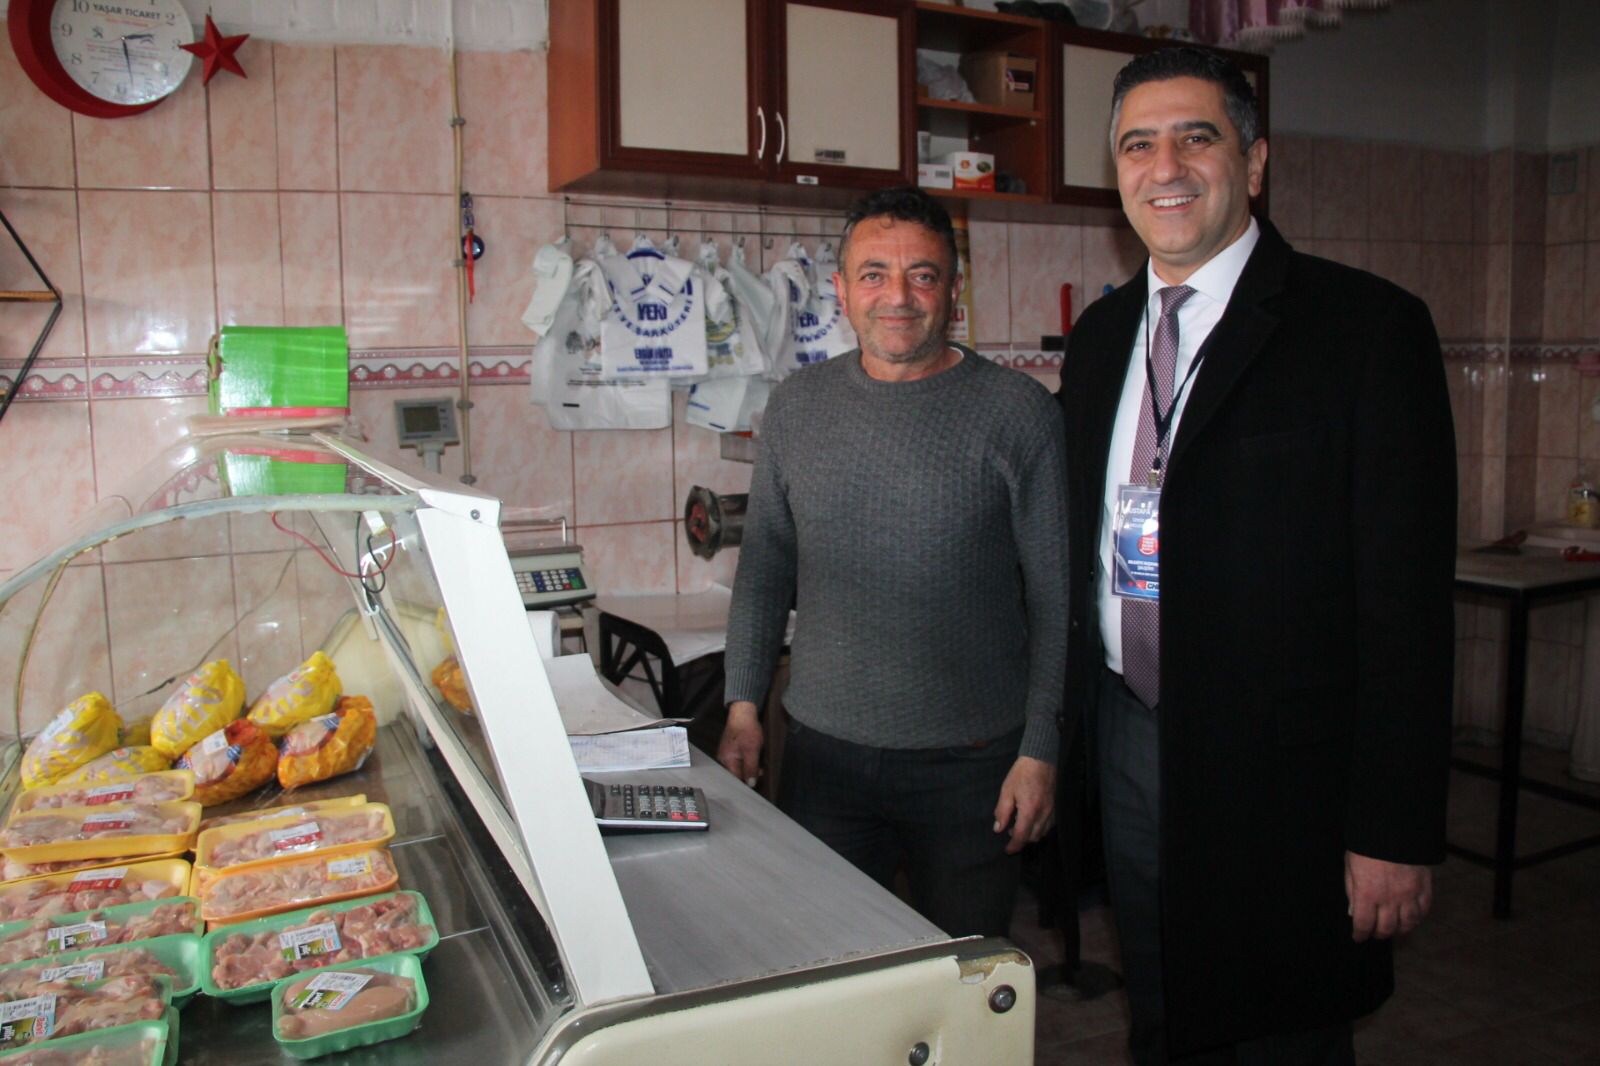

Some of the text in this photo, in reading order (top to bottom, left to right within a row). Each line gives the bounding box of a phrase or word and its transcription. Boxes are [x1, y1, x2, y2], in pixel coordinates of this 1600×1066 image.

[165, 12, 175, 26] 2
[61, 23, 73, 37] 9
[71, 52, 82, 65] 8
[91, 71, 99, 84] 7
